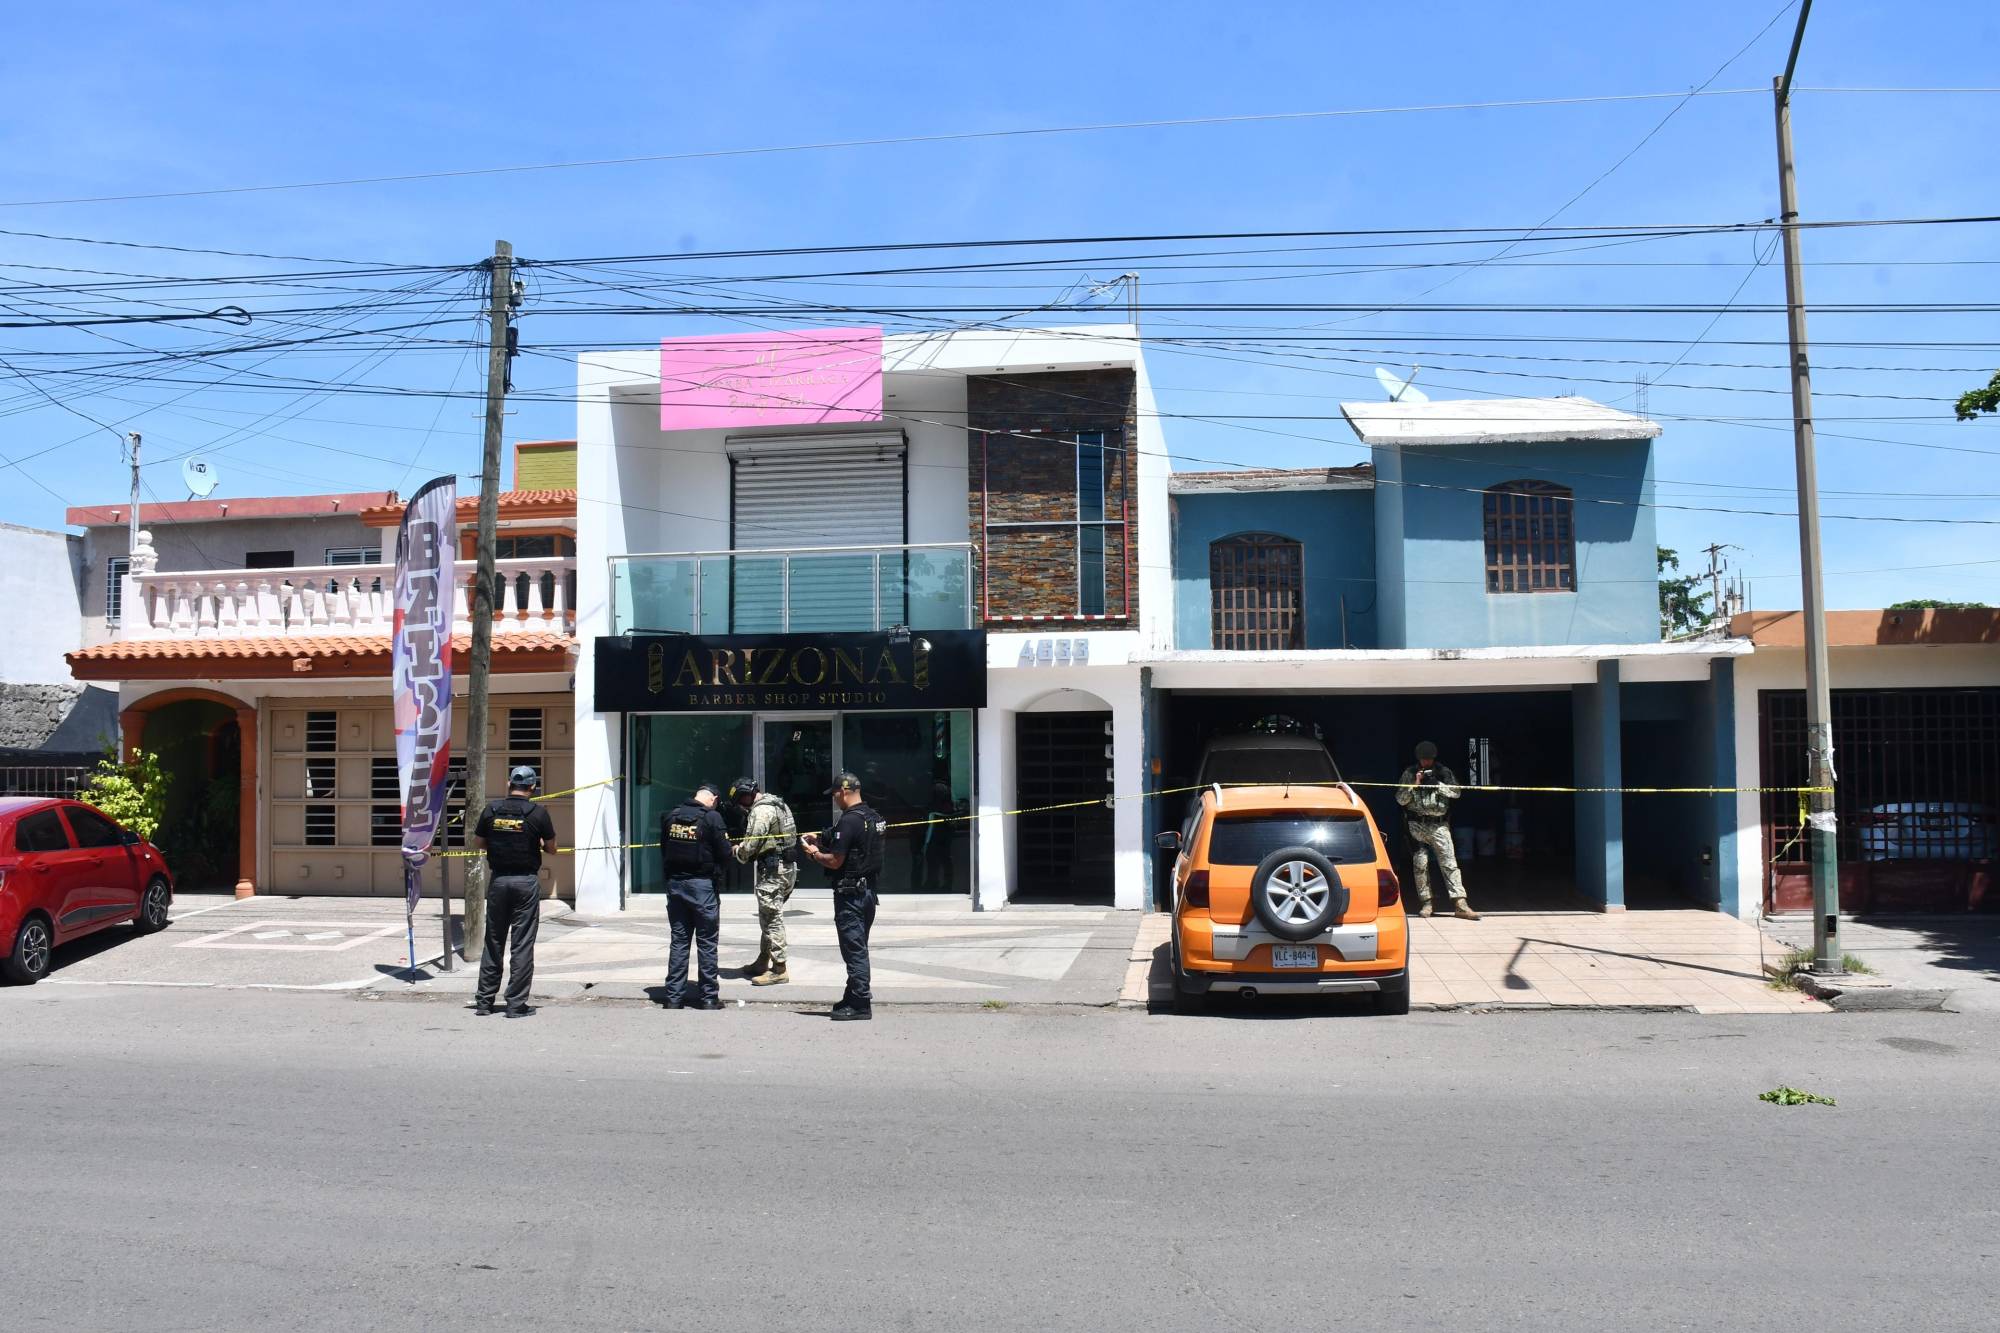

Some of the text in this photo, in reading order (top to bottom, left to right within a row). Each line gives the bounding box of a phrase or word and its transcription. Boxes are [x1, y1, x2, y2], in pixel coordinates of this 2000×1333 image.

[672, 646, 908, 687] ARIZONA
[689, 690, 887, 706] BARBER SHOP STUDIO
[669, 823, 698, 835] SSPC
[668, 832, 698, 841] FEDERAL
[1274, 950, 1317, 962] VLC-844-A
